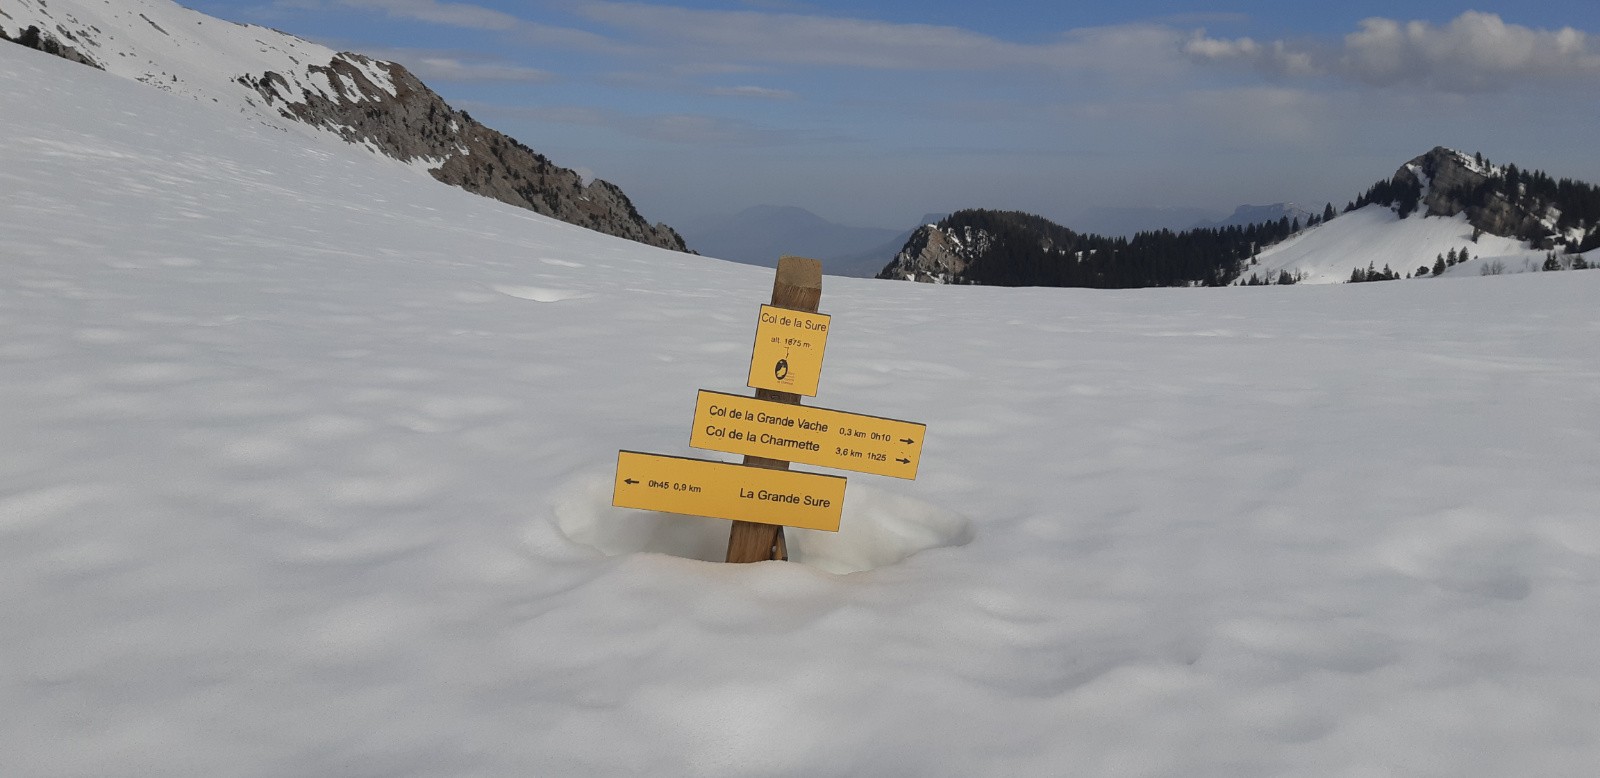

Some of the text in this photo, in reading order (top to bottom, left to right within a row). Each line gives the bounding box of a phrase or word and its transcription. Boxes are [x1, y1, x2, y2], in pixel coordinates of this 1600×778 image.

[762, 313, 827, 332] Col de la Sure
[710, 406, 891, 442] Col de la Grande Vache 0,3 km 0h10
[706, 426, 886, 462] Col de la Charmette 3,6 km 1h25
[648, 480, 830, 508] 0h45 0,9 km La Grande Sure
